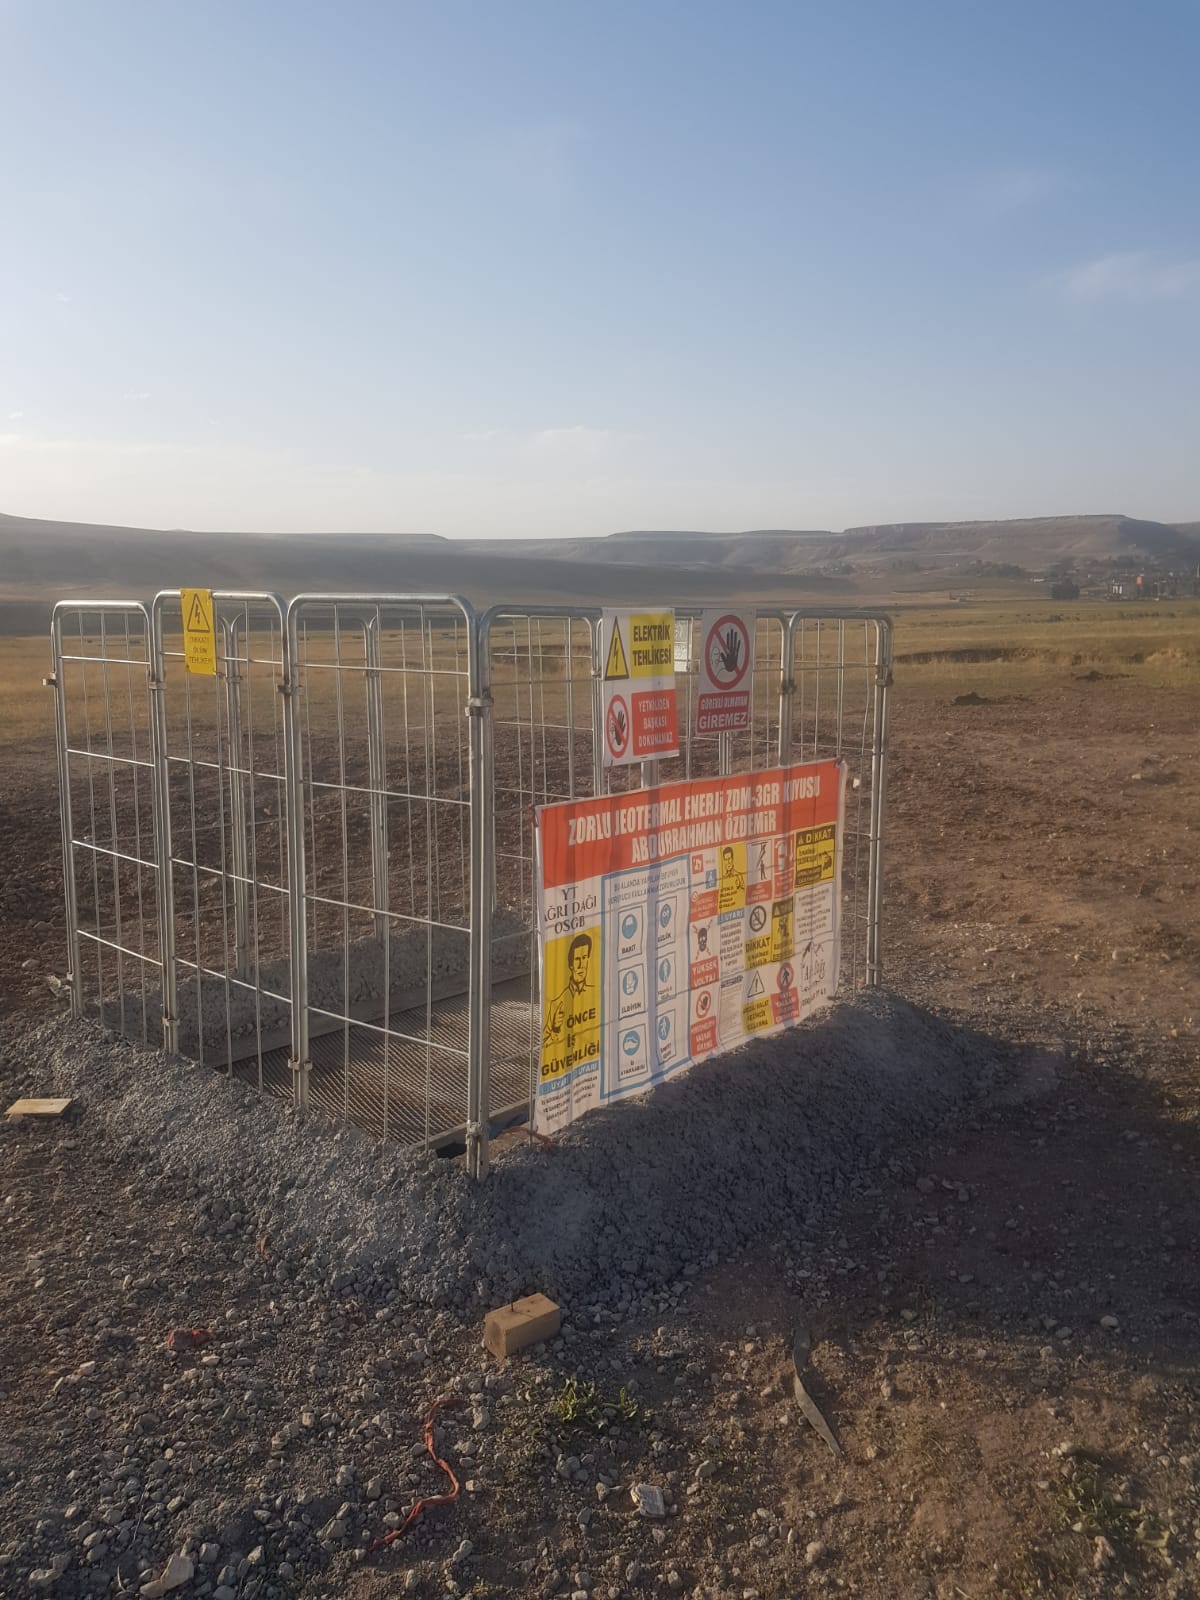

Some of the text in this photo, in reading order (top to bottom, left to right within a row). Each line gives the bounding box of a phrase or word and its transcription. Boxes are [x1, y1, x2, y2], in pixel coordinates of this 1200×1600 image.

[634, 621, 670, 642] ELEKTRİK
[633, 645, 671, 666] TEHLİKESİ
[700, 711, 747, 730] GİREMEZ
[568, 812, 611, 846] ZORLU
[615, 798, 682, 836] JEOTERMAL
[784, 776, 820, 803] KUYUSU
[631, 819, 722, 863] ABDURRAHMAN
[562, 886, 578, 900] YT
[572, 894, 596, 914] DAĞI
[555, 916, 585, 934] OSGB
[567, 1008, 596, 1029] ÖNCE
[567, 1034, 576, 1048] İŞ
[541, 1040, 600, 1076] GÜVENLİĞİ
